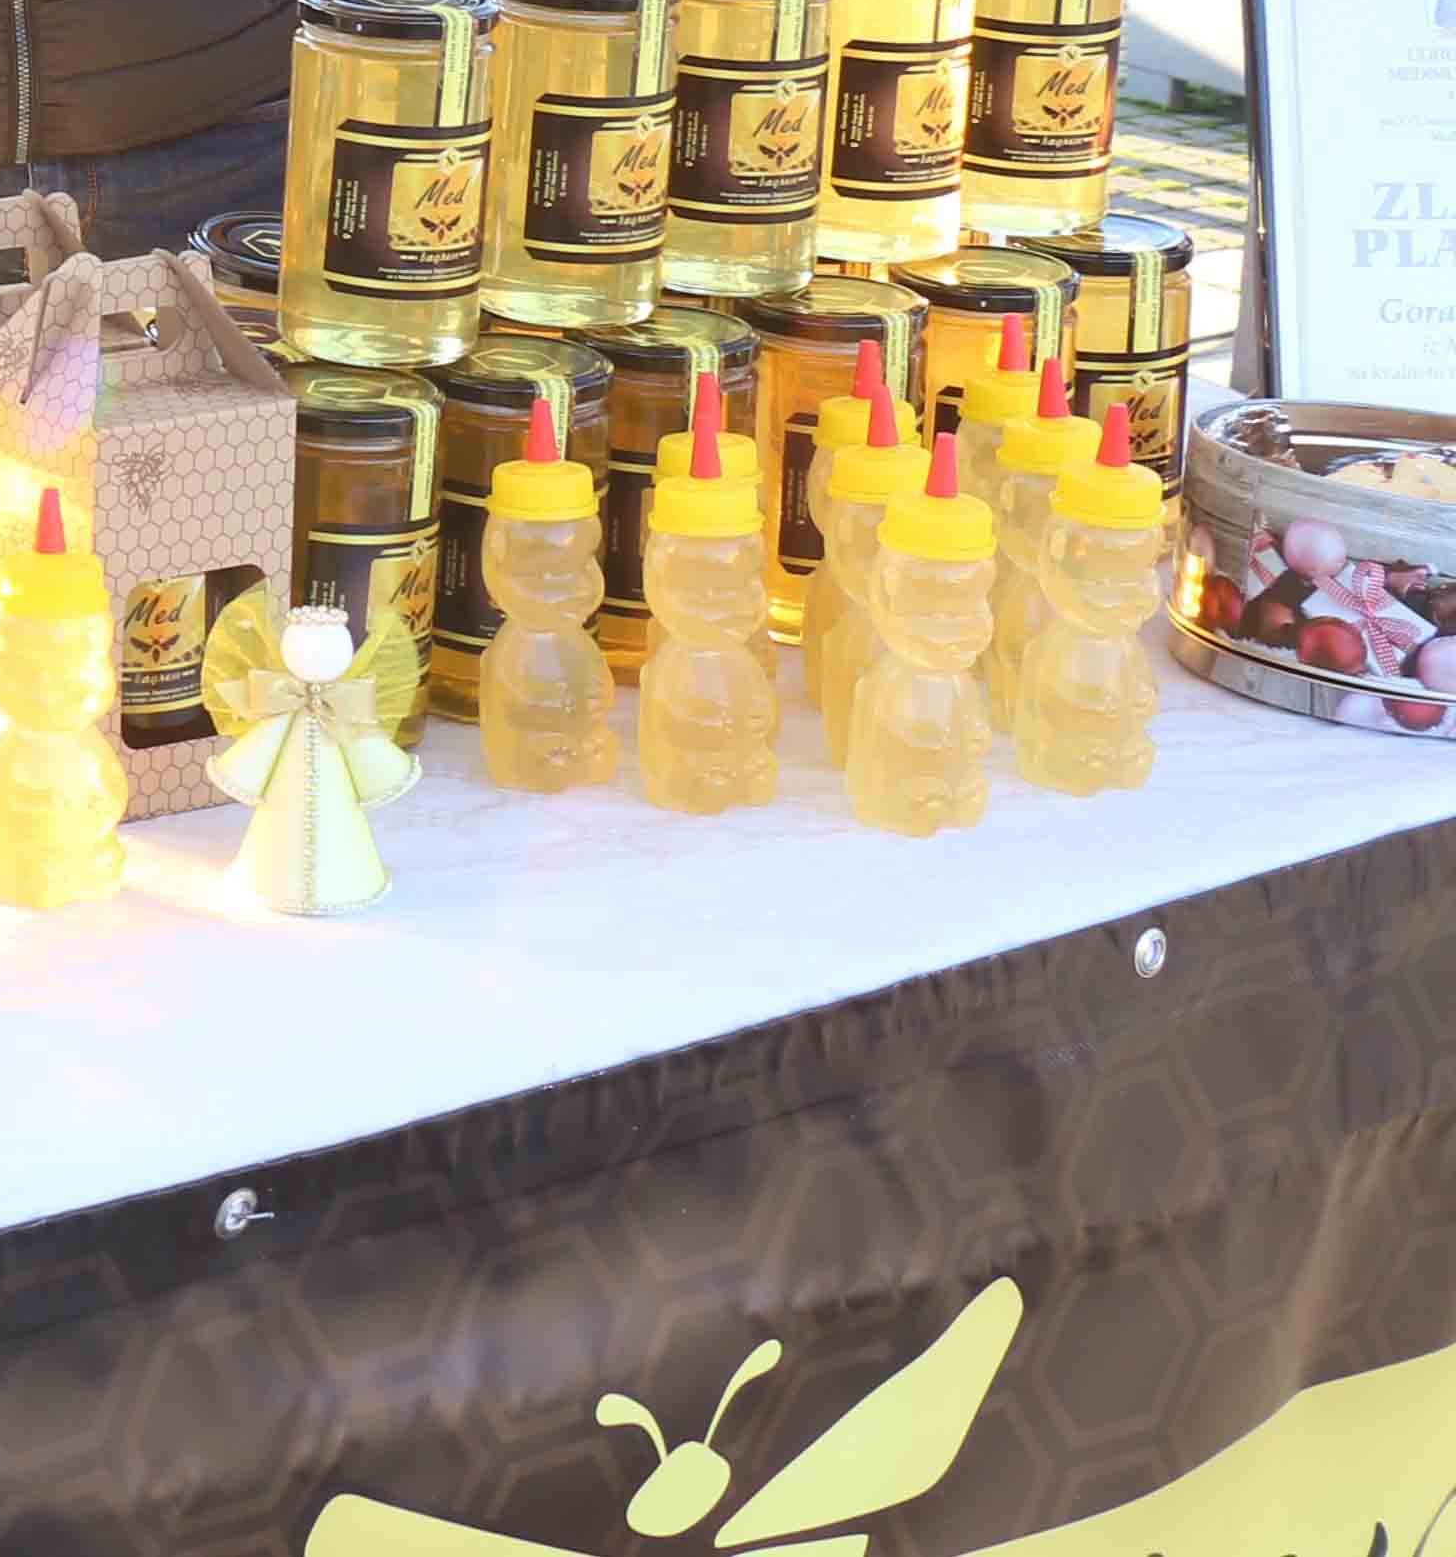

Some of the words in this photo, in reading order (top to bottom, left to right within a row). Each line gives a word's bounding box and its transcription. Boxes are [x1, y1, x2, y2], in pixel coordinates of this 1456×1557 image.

[1035, 68, 1096, 99] Med
[752, 106, 810, 138] Med
[415, 174, 472, 211] Med
[1372, 180, 1456, 221] ZL
[123, 594, 188, 631] Med
